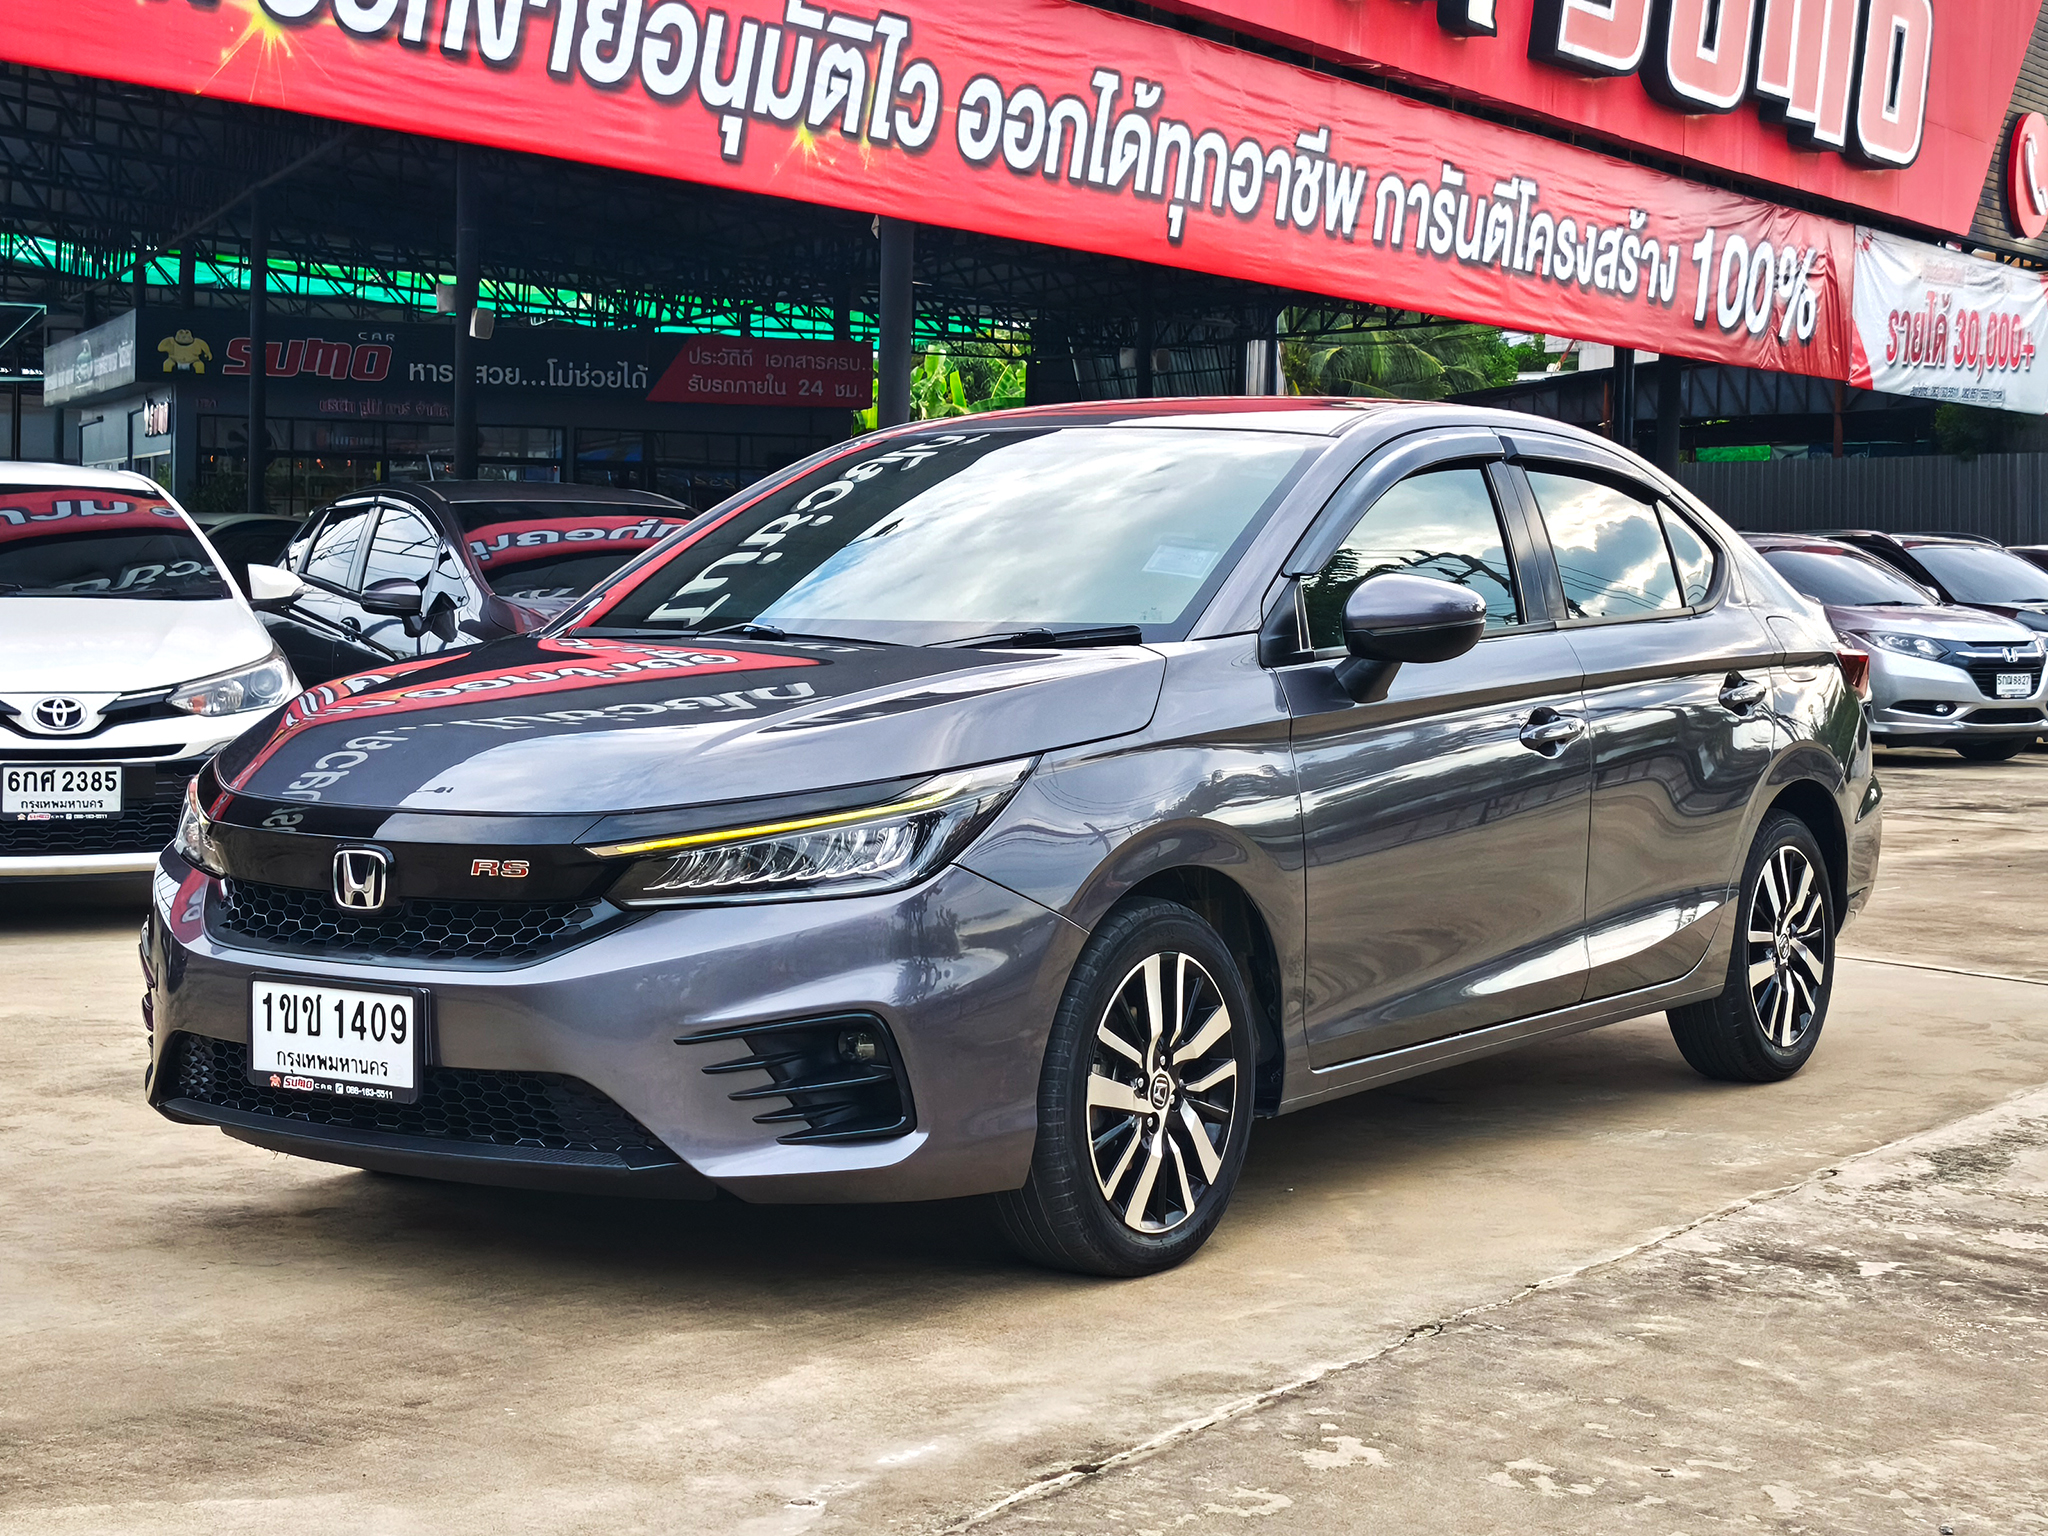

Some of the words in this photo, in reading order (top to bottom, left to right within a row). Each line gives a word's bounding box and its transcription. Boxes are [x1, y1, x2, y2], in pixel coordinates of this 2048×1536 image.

[958, 69, 1367, 239] ออกได้ทุกอาชีพ
[1372, 162, 1680, 303] การันตีโครงสร้าง
[1692, 227, 1818, 341] 100%
[358, 332, 396, 342] CAR
[1885, 290, 1952, 368] รายได้
[1953, 308, 2035, 384] 30,000+
[688, 346, 754, 367] ประวัติดี
[687, 372, 787, 396] รับรถภายใน
[797, 379, 824, 397] 24
[834, 383, 864, 399] ชม.
[7, 769, 56, 793] 6กศ
[61, 770, 117, 793] 2385
[21, 799, 104, 813] กรุงเทพมหานคร
[470, 858, 530, 878] RS
[262, 992, 323, 1037] 1ขช
[334, 999, 407, 1045] 1409
[276, 1050, 389, 1077] กรุงเทพมหานคร
[284, 1076, 314, 1090] SUMO
[314, 1082, 333, 1092] CAR
